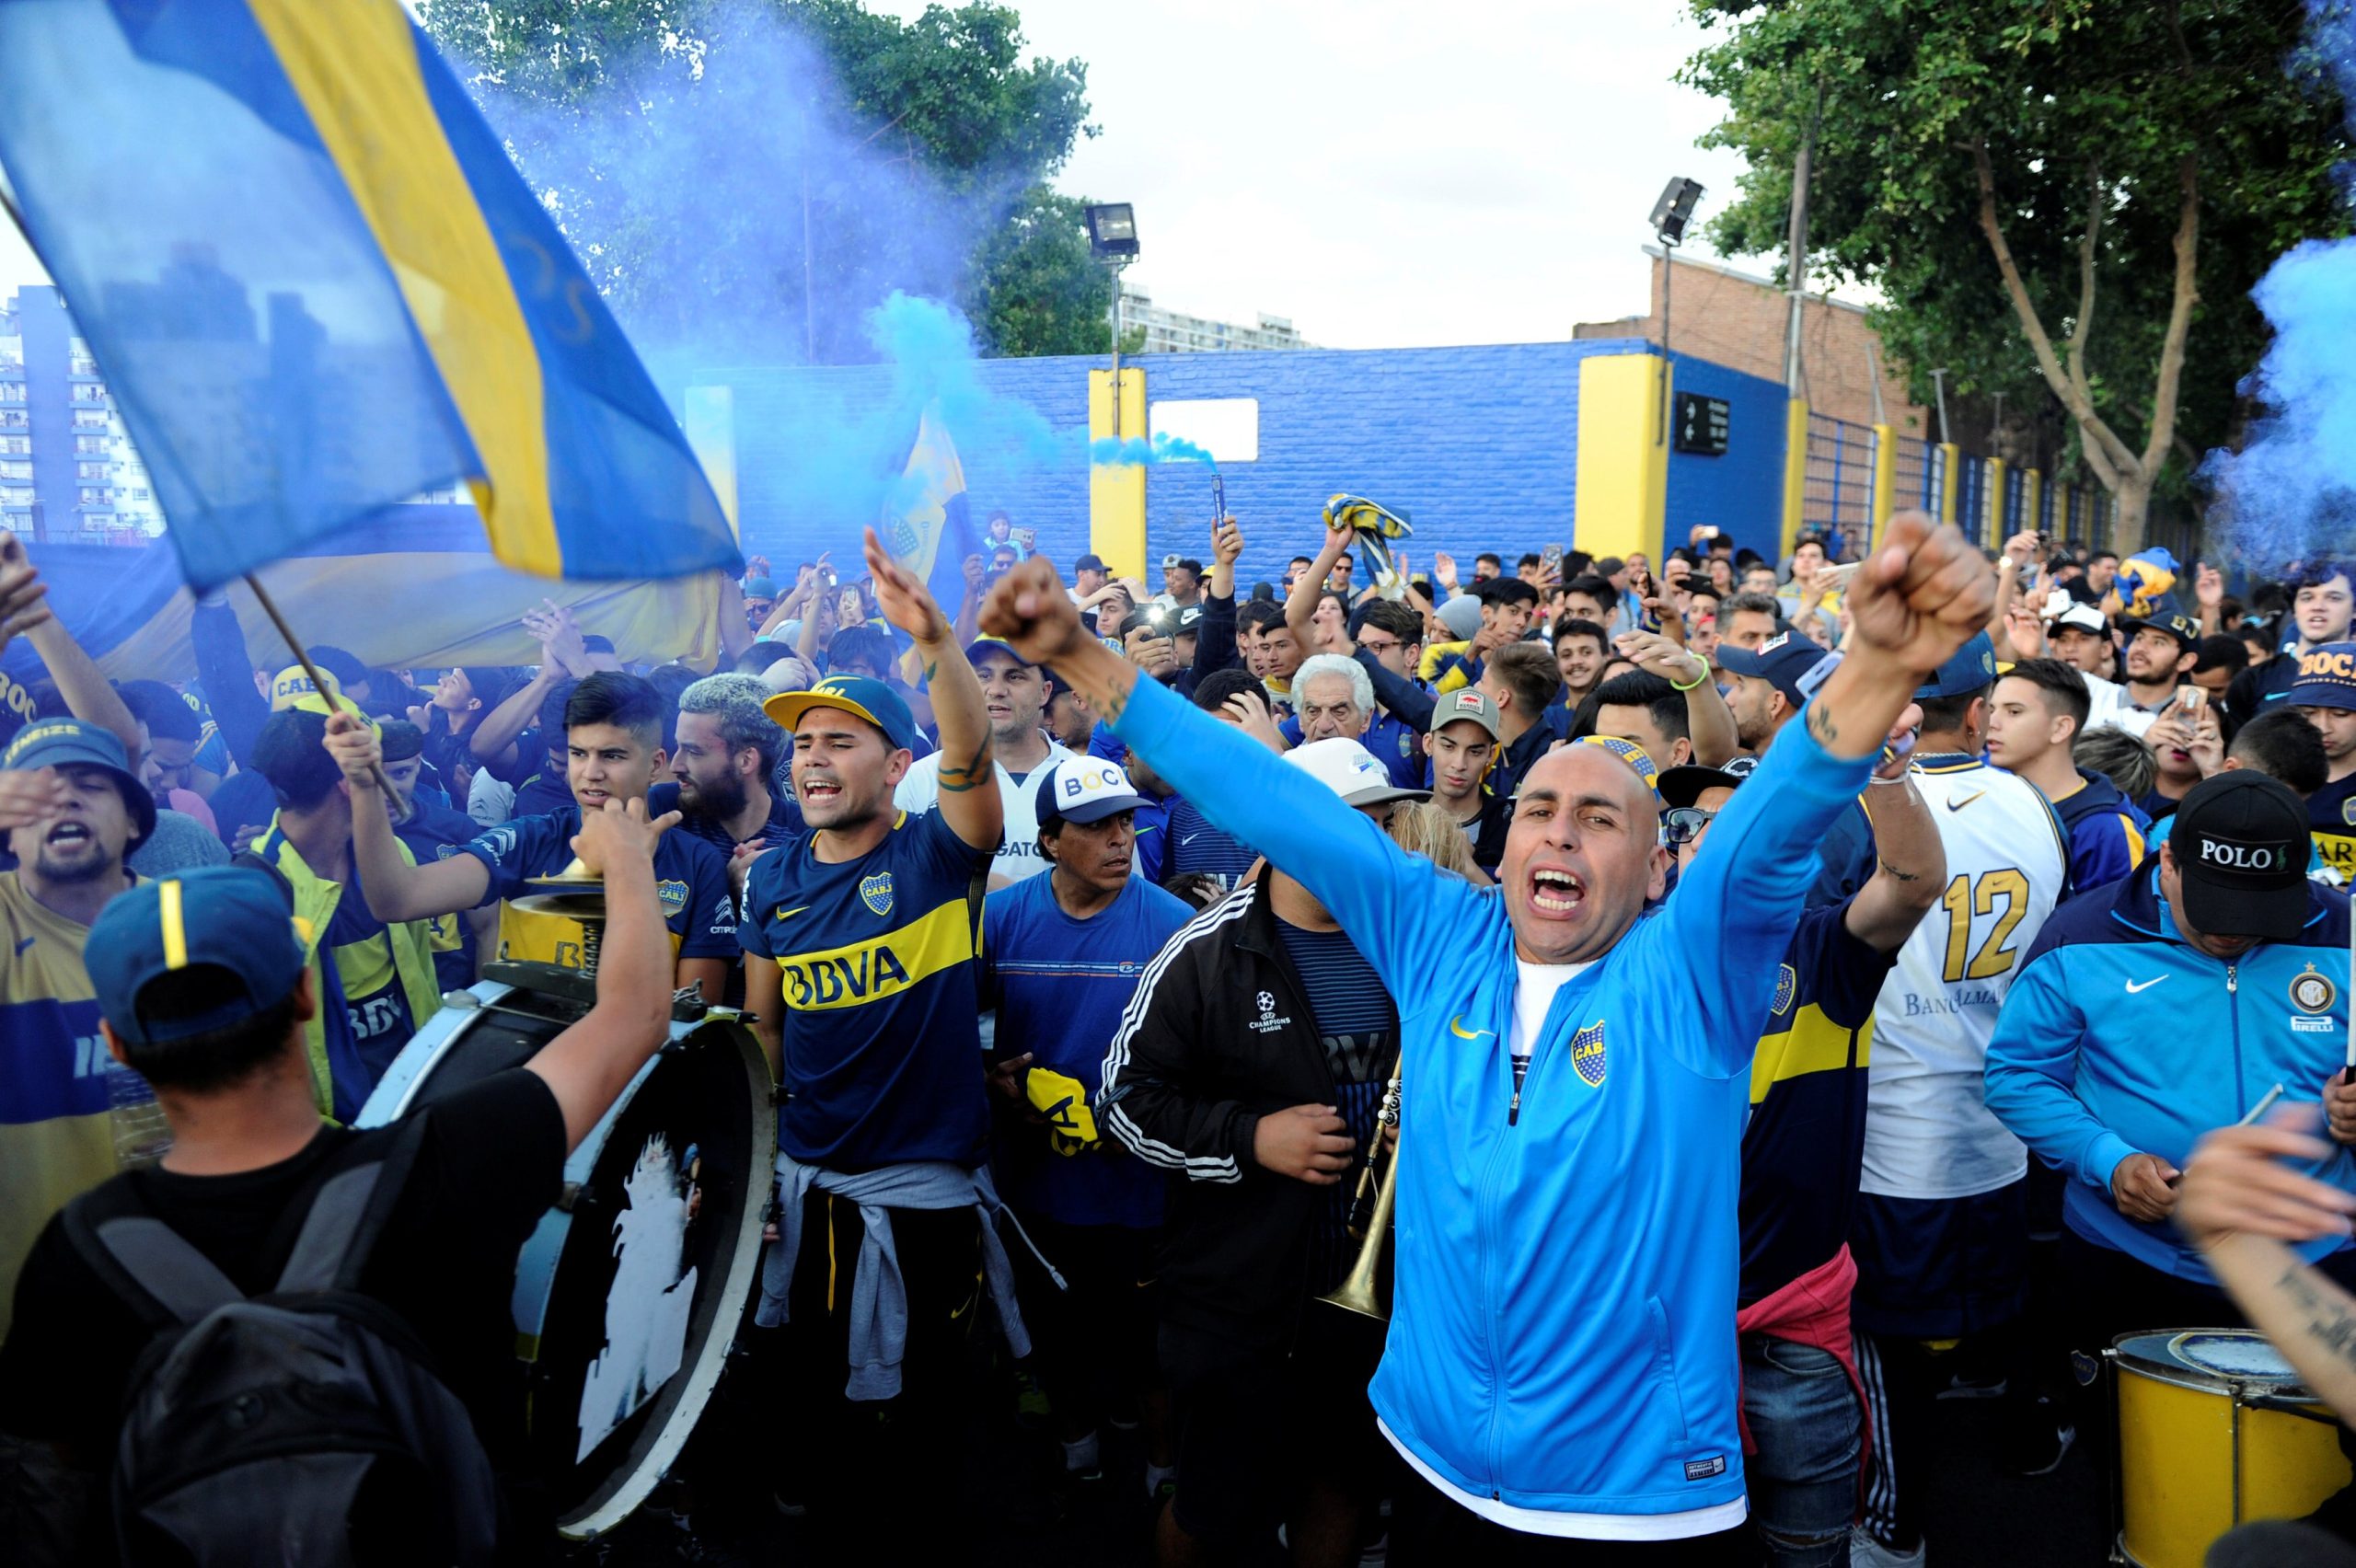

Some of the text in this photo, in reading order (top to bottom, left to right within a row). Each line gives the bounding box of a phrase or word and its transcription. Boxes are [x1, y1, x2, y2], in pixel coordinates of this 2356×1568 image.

[2200, 838, 2272, 870] POLO
[658, 889, 685, 902] CABJ
[865, 883, 893, 898] CABJ
[1942, 867, 2030, 984] 12
[783, 945, 911, 1006] BBVA
[1249, 1017, 1290, 1029] CHAMPIONS
[1259, 1024, 1282, 1033] LEAGUE
[2290, 1015, 2335, 1032] PIRELLI
